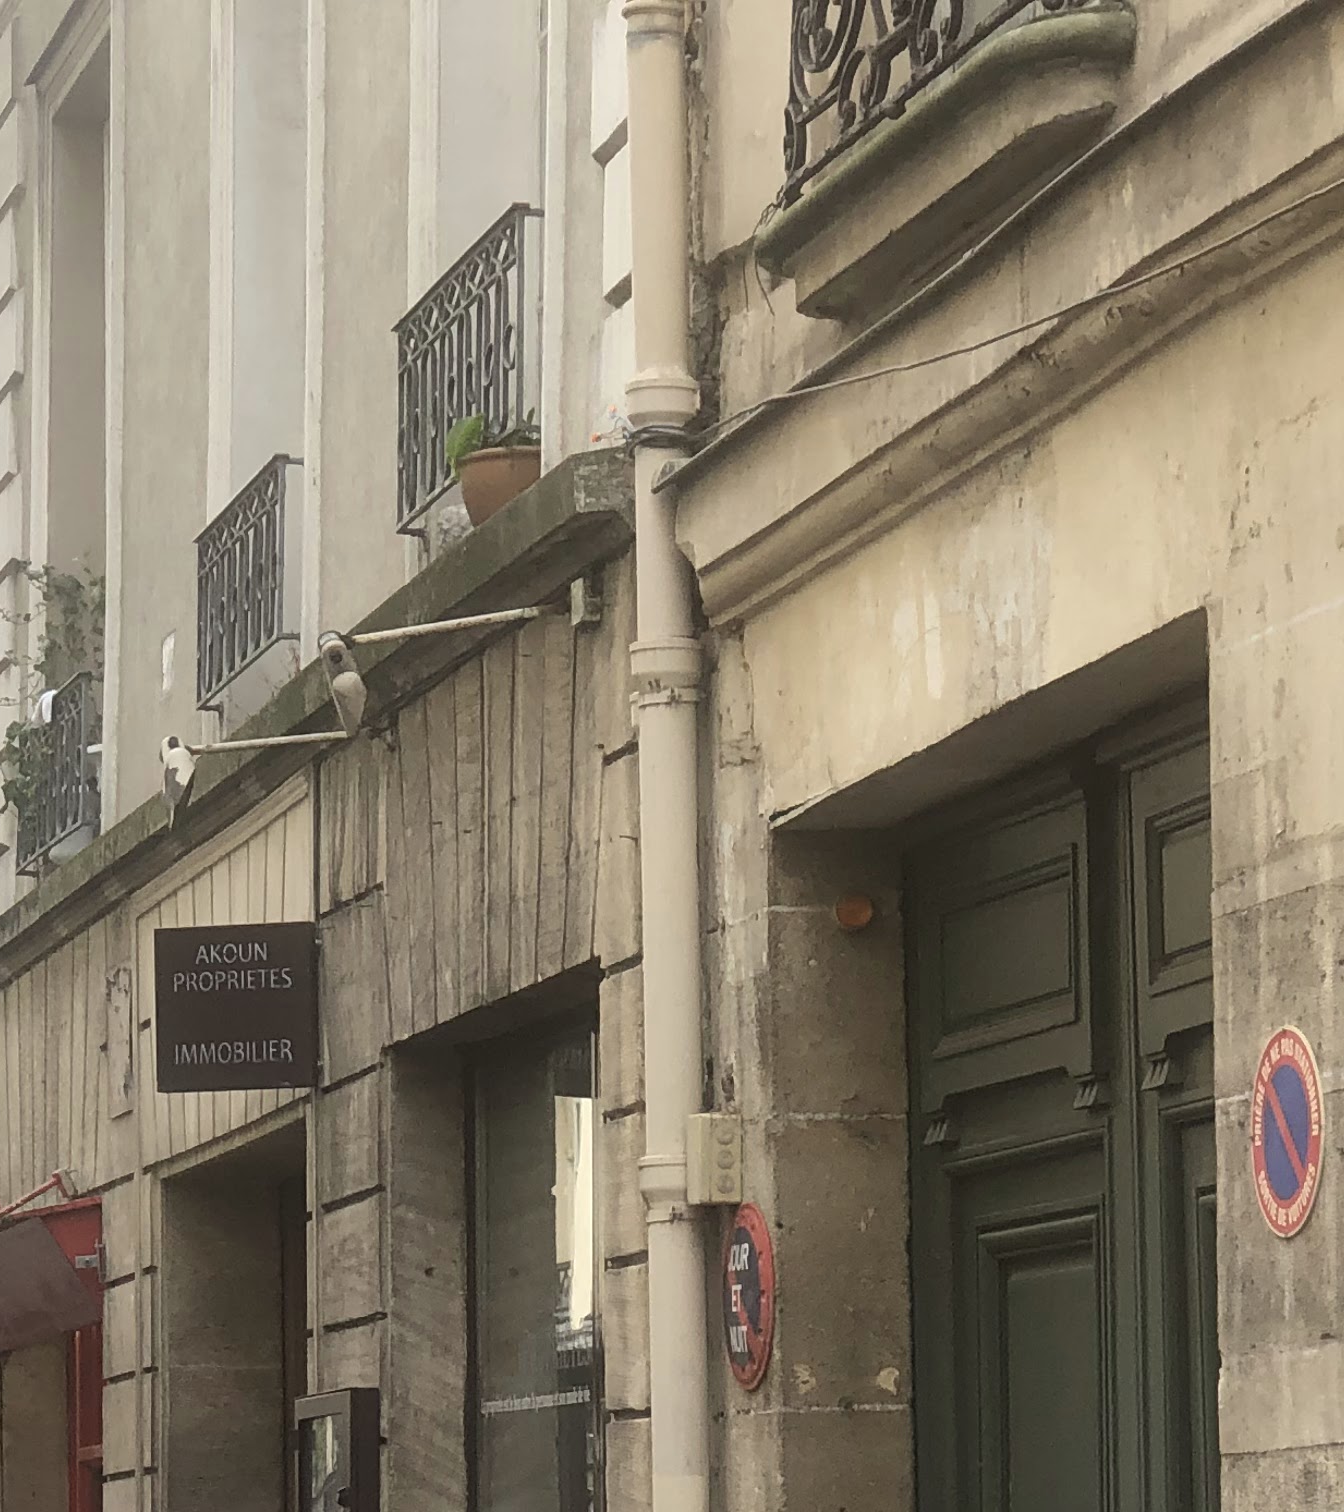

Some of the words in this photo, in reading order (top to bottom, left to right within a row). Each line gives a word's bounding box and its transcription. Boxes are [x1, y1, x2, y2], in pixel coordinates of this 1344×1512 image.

[195, 941, 269, 966] AKOUN
[173, 967, 293, 993] PROPRIETES
[175, 1038, 294, 1066] IMMOBILIER
[727, 1242, 751, 1273] JOUR
[731, 1283, 743, 1314] ET
[729, 1324, 749, 1354] NUIT
